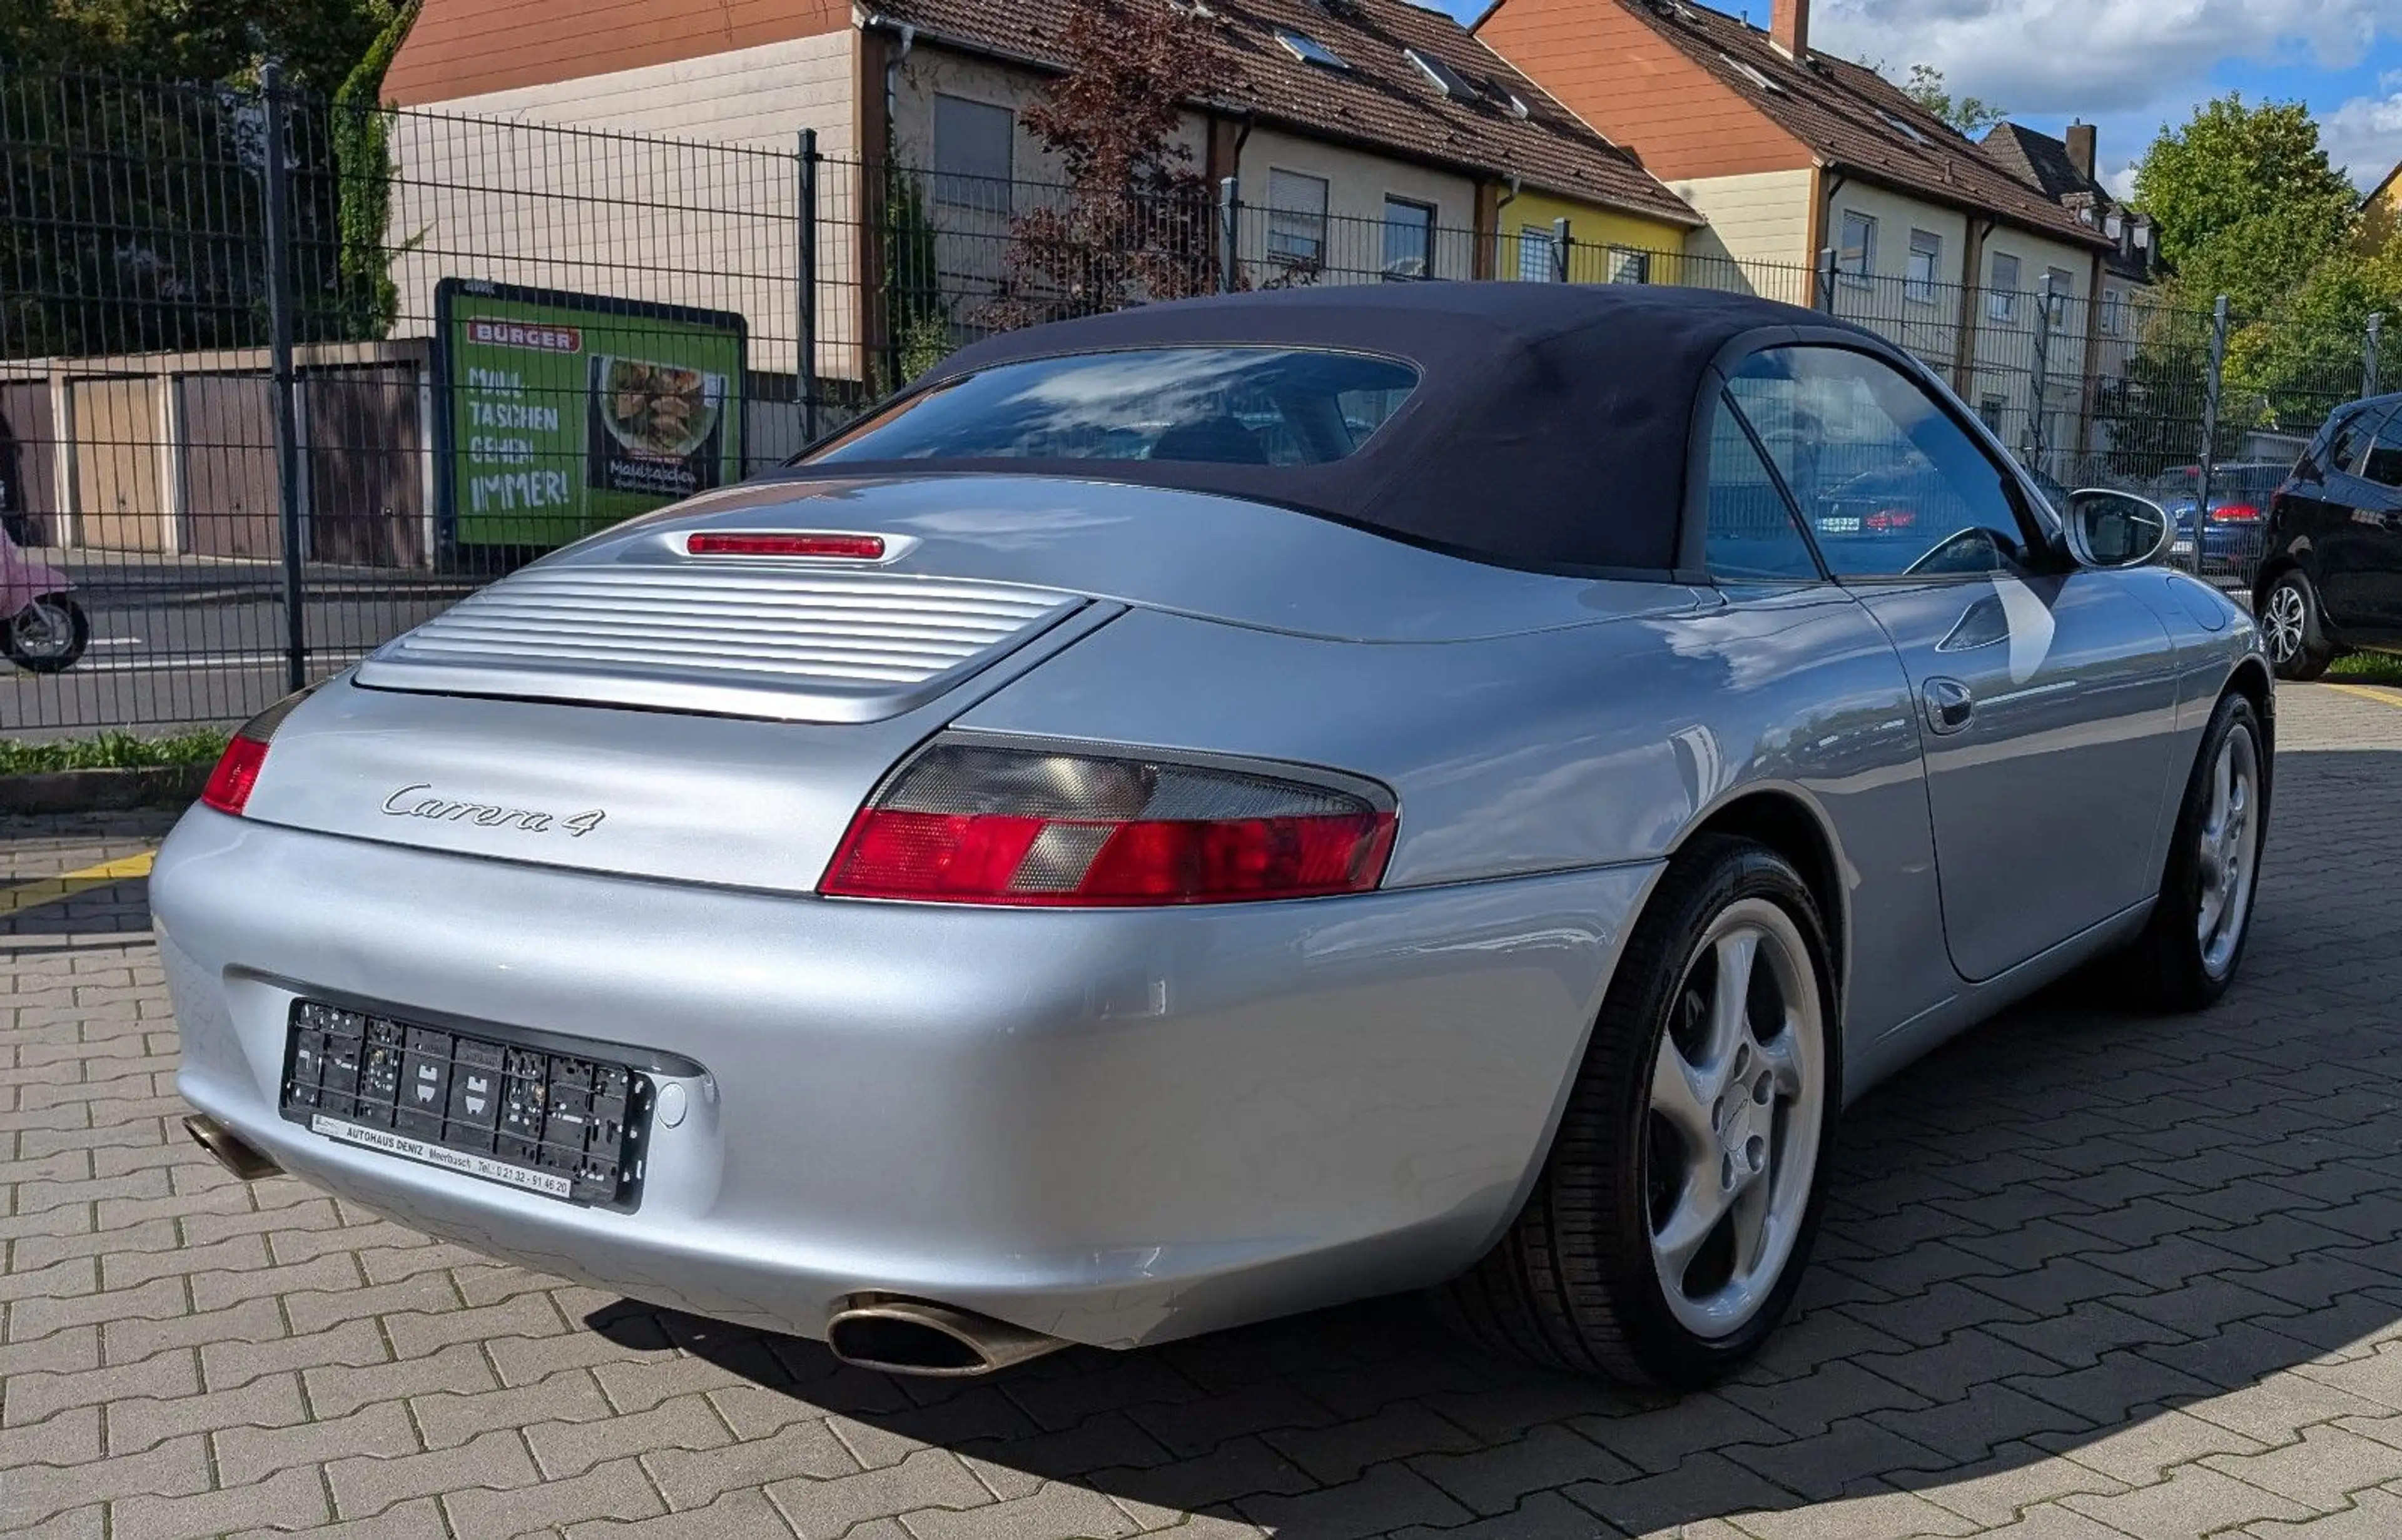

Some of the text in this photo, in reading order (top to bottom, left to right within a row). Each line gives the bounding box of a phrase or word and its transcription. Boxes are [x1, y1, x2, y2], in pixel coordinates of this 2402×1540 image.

[469, 400, 559, 432] TASCHEN
[471, 436, 534, 464] GEHEN
[470, 470, 570, 512] IMMER!
[382, 783, 607, 837] Carrera 4
[347, 1127, 394, 1148] AUTOHAUS
[396, 1140, 423, 1155] DENIZ
